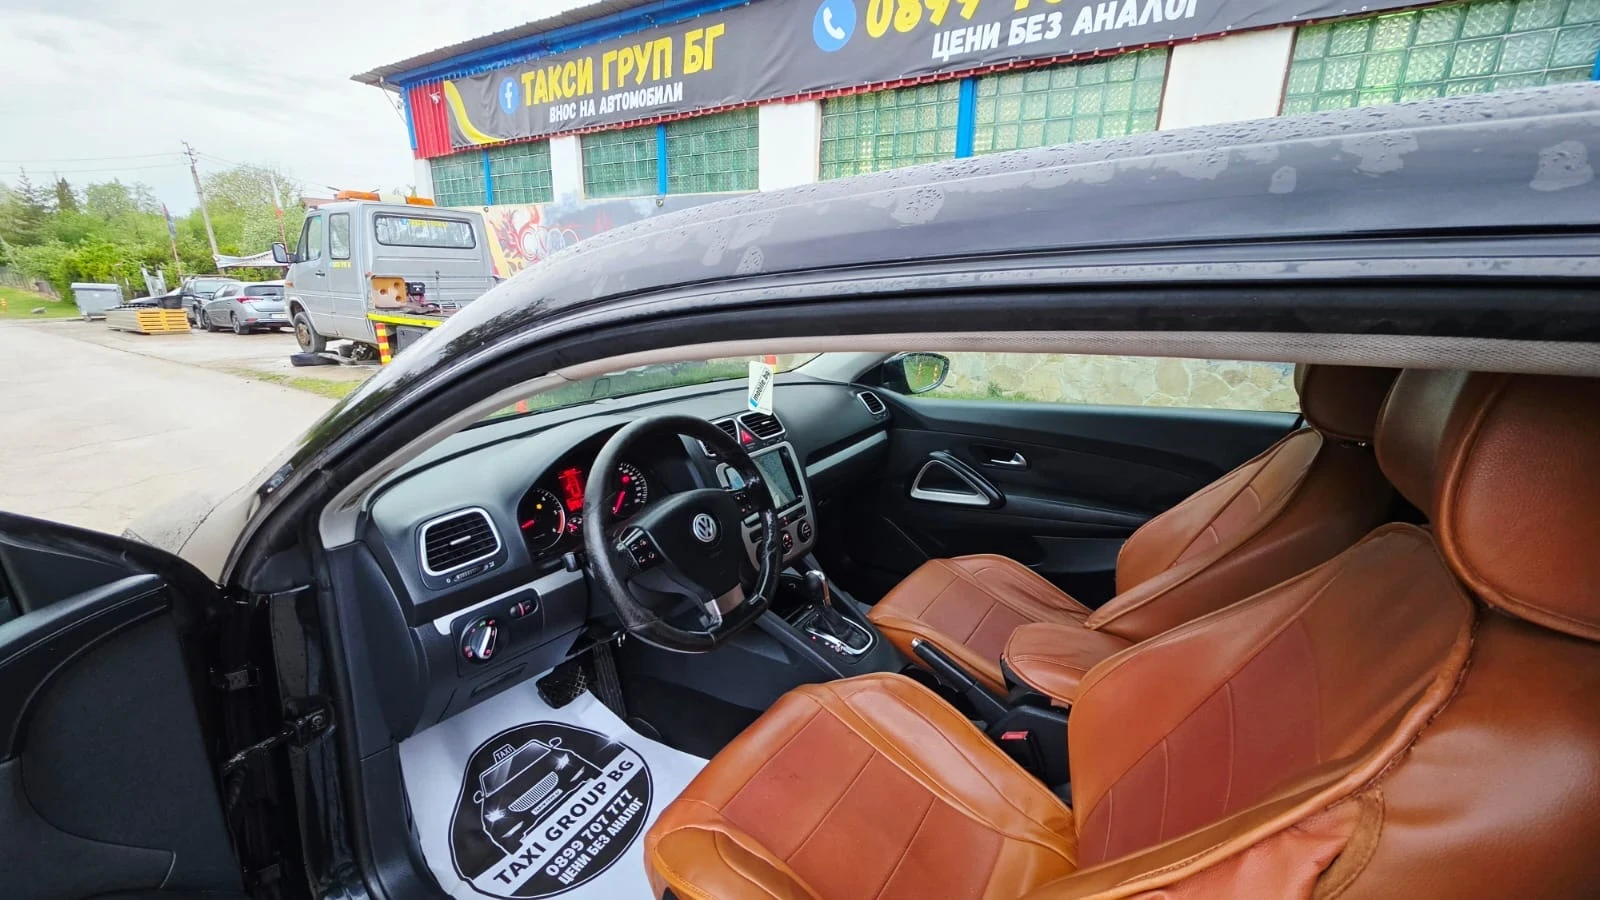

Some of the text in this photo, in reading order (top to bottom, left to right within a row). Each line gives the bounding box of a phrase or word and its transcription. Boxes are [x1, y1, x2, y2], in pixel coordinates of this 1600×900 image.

[521, 23, 725, 107] ТАКСИ ГРУП БГ
[931, 22, 1001, 61] ЦЕНИ
[1007, 12, 1063, 46] БЕЗ
[549, 81, 684, 123] ВНОС НА АВТОМОБИЛИ
[495, 746, 513, 760] TAXI
[493, 842, 547, 885] TAXI
[545, 781, 608, 842] GROUP
[606, 760, 634, 782] BG
[545, 840, 584, 877] 0899
[581, 814, 609, 840] 707
[606, 789, 633, 815] 777
[558, 796, 644, 885] ЦЕНИ БЕЗ АНАЛОГ
